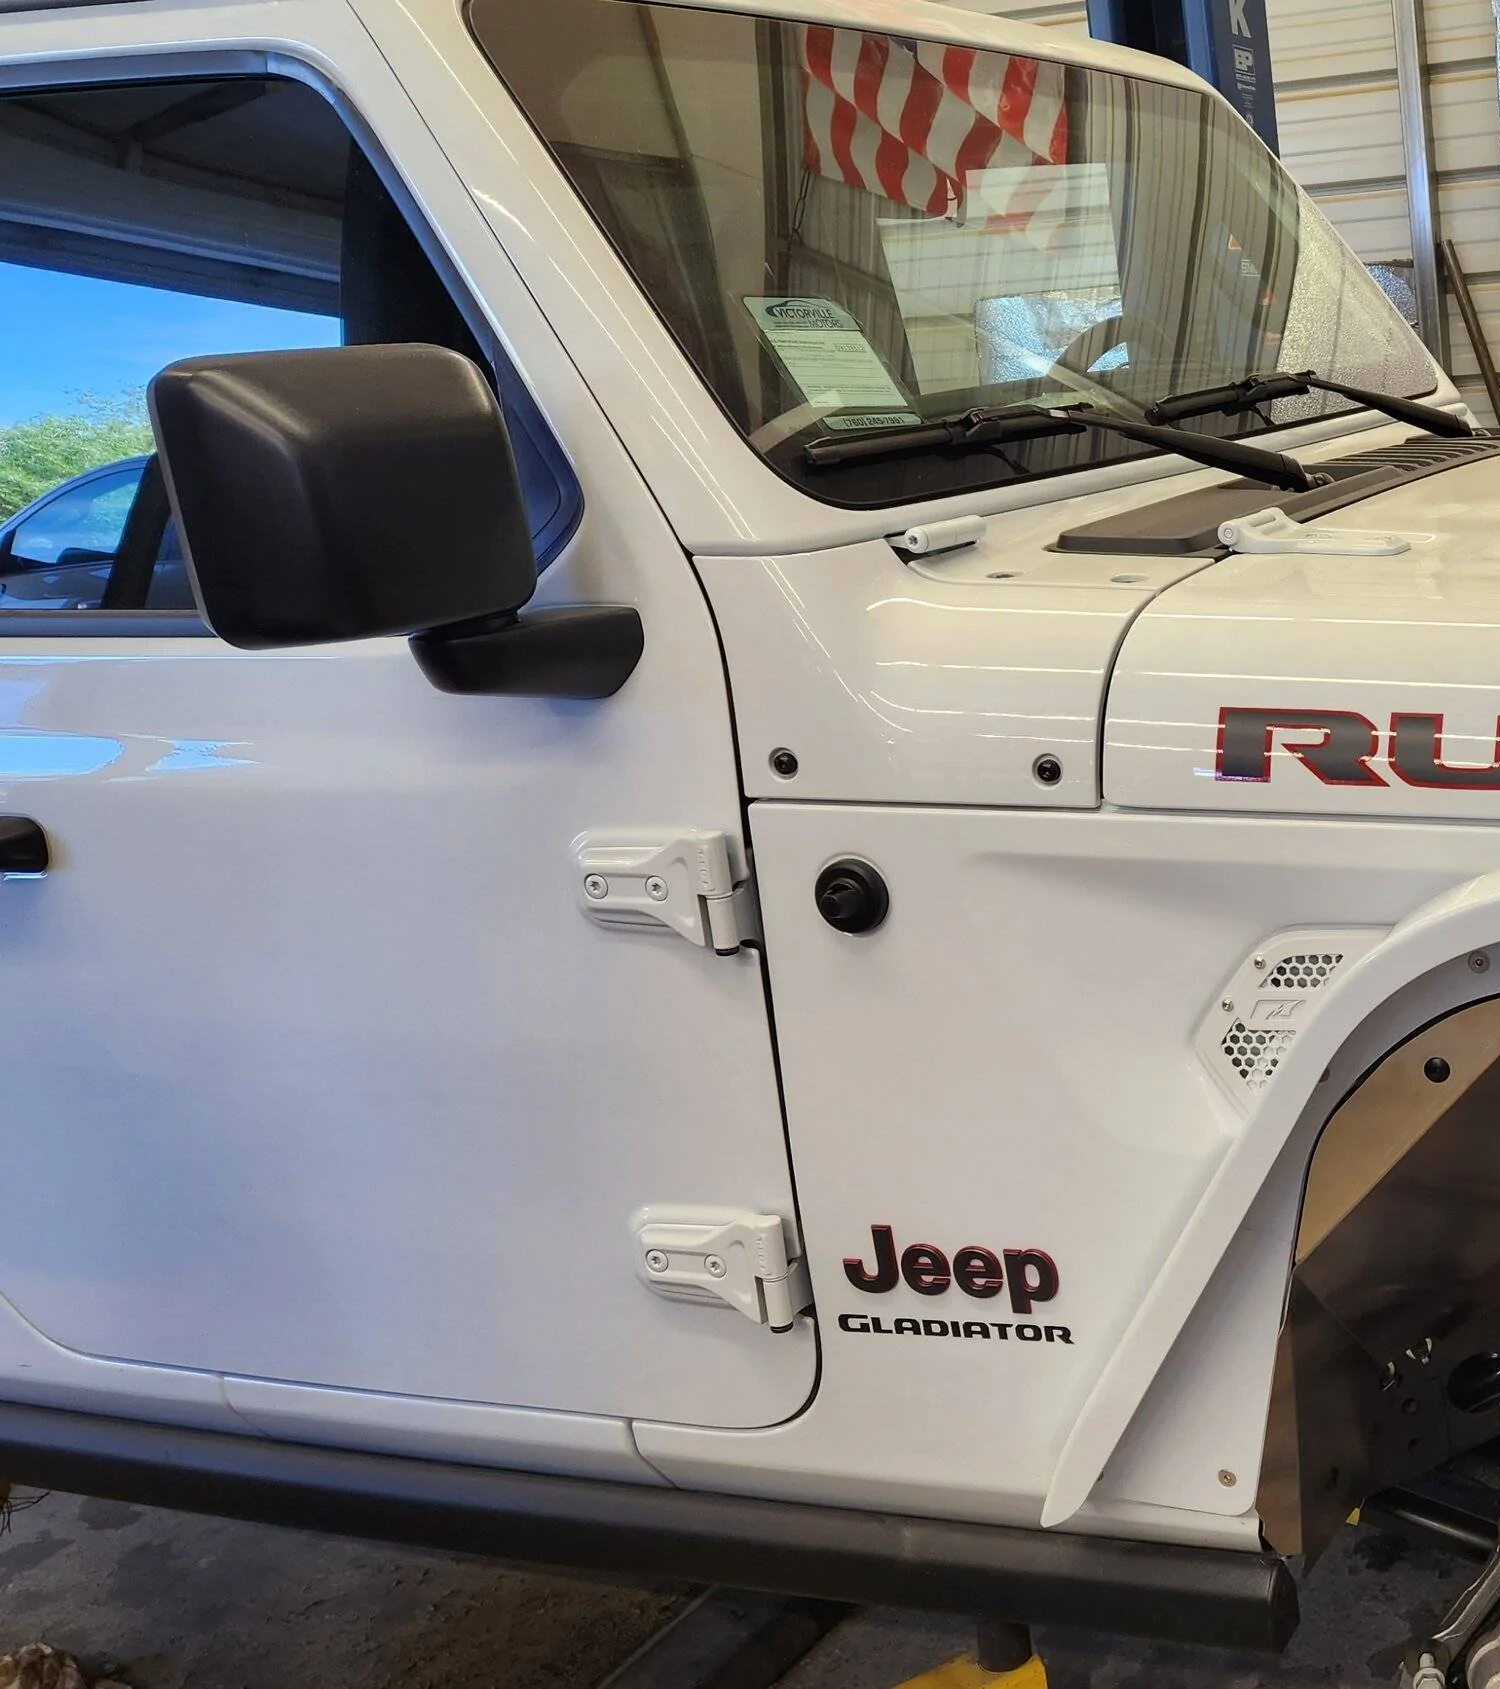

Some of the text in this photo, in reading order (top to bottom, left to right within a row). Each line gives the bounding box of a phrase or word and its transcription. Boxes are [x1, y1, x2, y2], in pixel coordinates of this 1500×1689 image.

[775, 308, 836, 319] VICTORVILLE
[808, 319, 843, 329] MOTORS
[842, 1224, 1060, 1314] Jeep
[838, 1313, 1076, 1345] GLADIATOR
